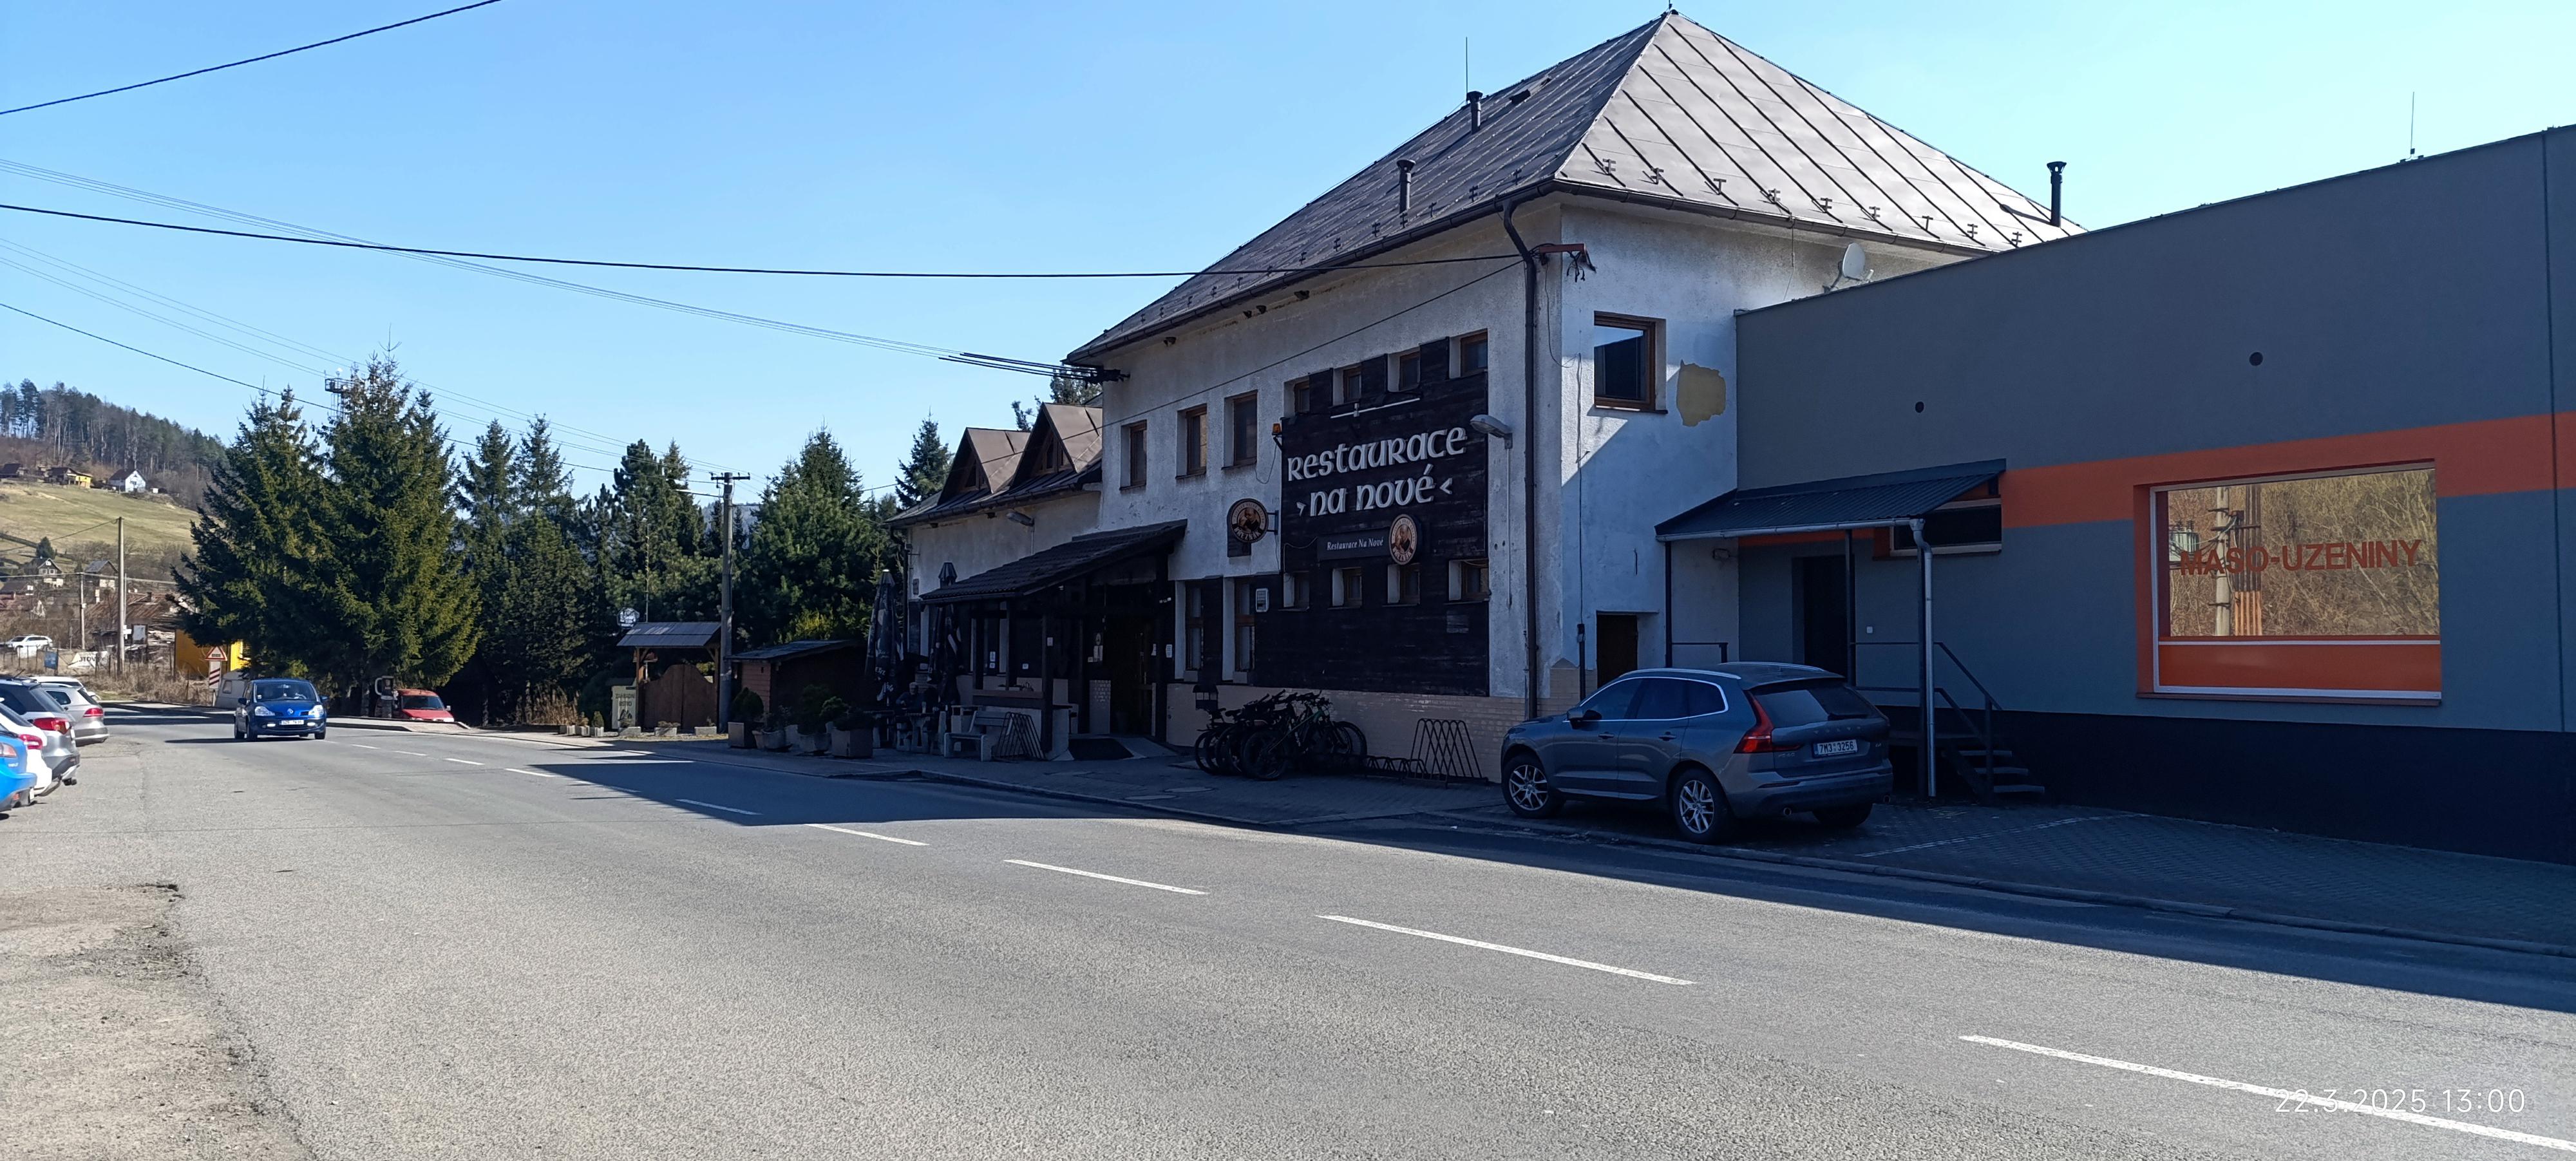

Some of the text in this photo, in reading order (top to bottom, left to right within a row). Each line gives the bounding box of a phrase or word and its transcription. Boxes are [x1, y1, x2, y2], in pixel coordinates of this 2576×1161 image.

[1327, 536, 1384, 551] Restaurace Na Nové
[2179, 539, 2422, 576] MASO-UZENINY
[1837, 741, 1854, 751] 3256
